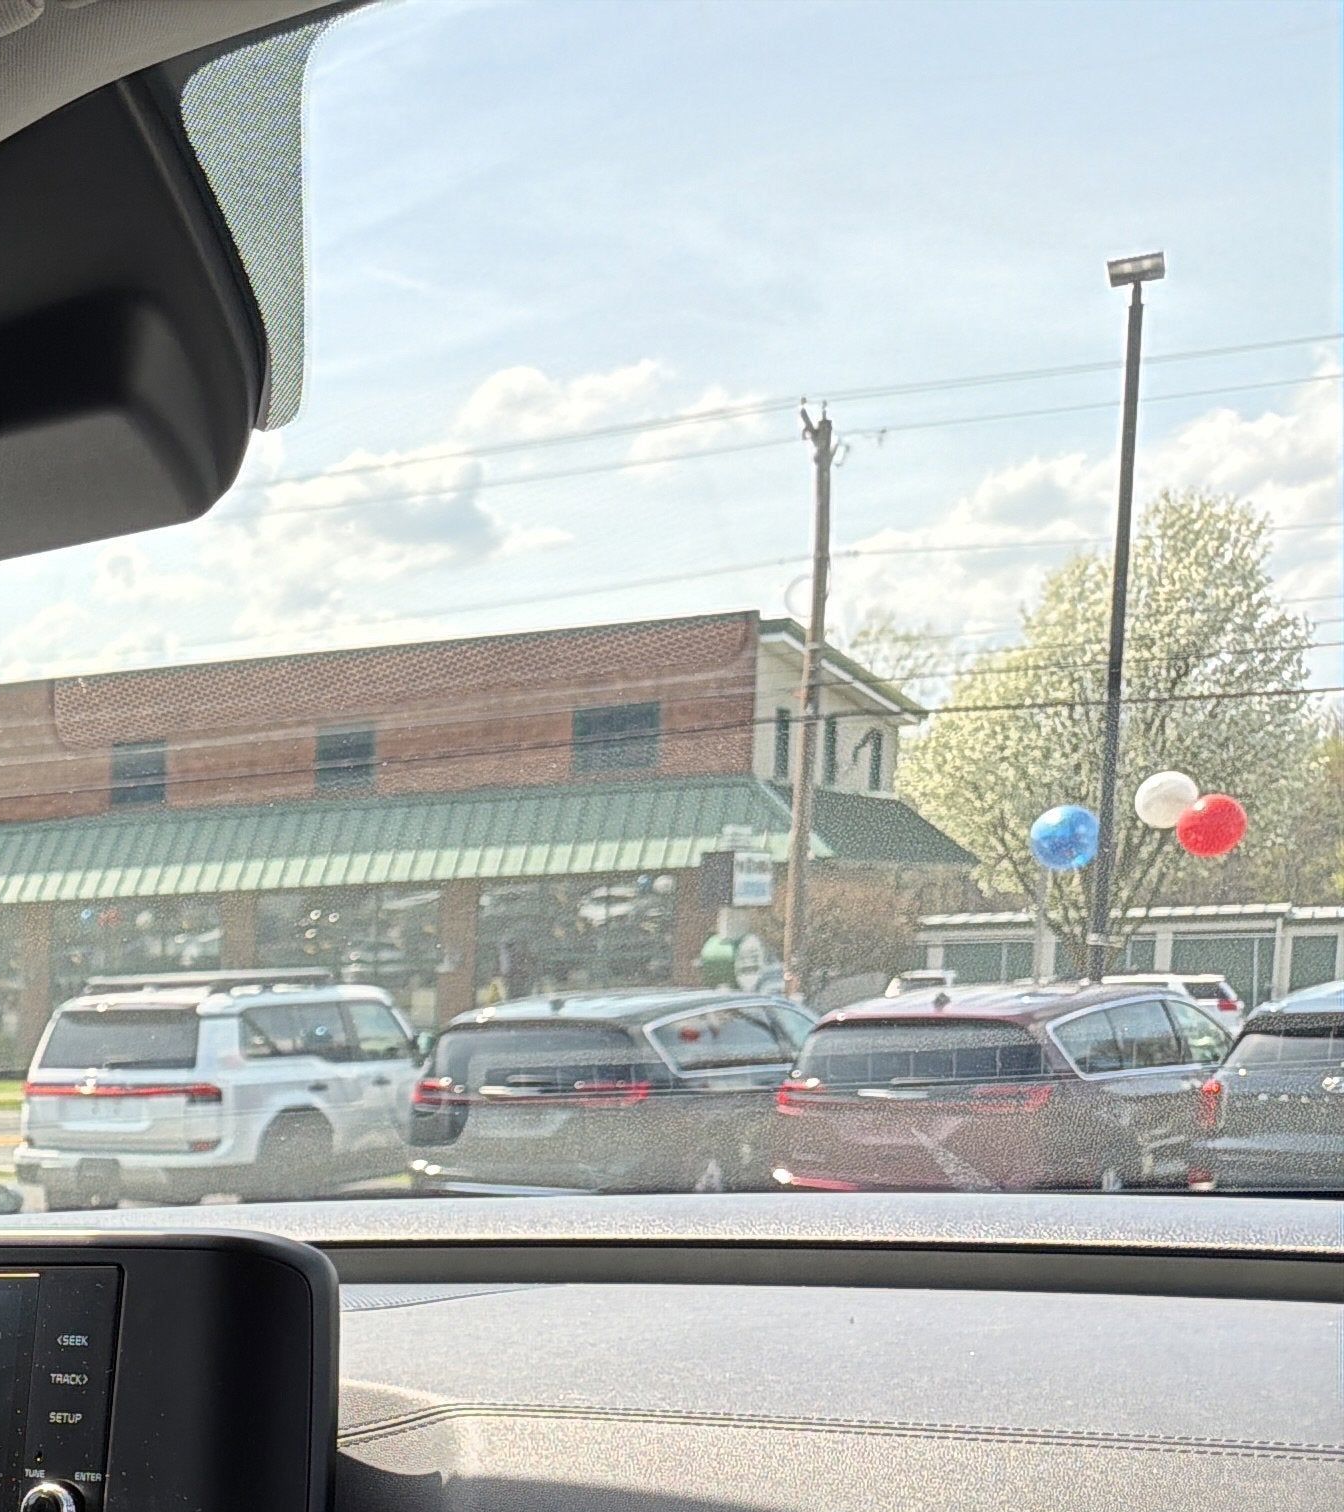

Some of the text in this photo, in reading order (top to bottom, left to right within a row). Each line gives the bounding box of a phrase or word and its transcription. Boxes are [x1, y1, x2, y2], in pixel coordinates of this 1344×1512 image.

[49, 1412, 83, 1424] SETUP
[24, 1468, 102, 1482] TUNE ENTER
